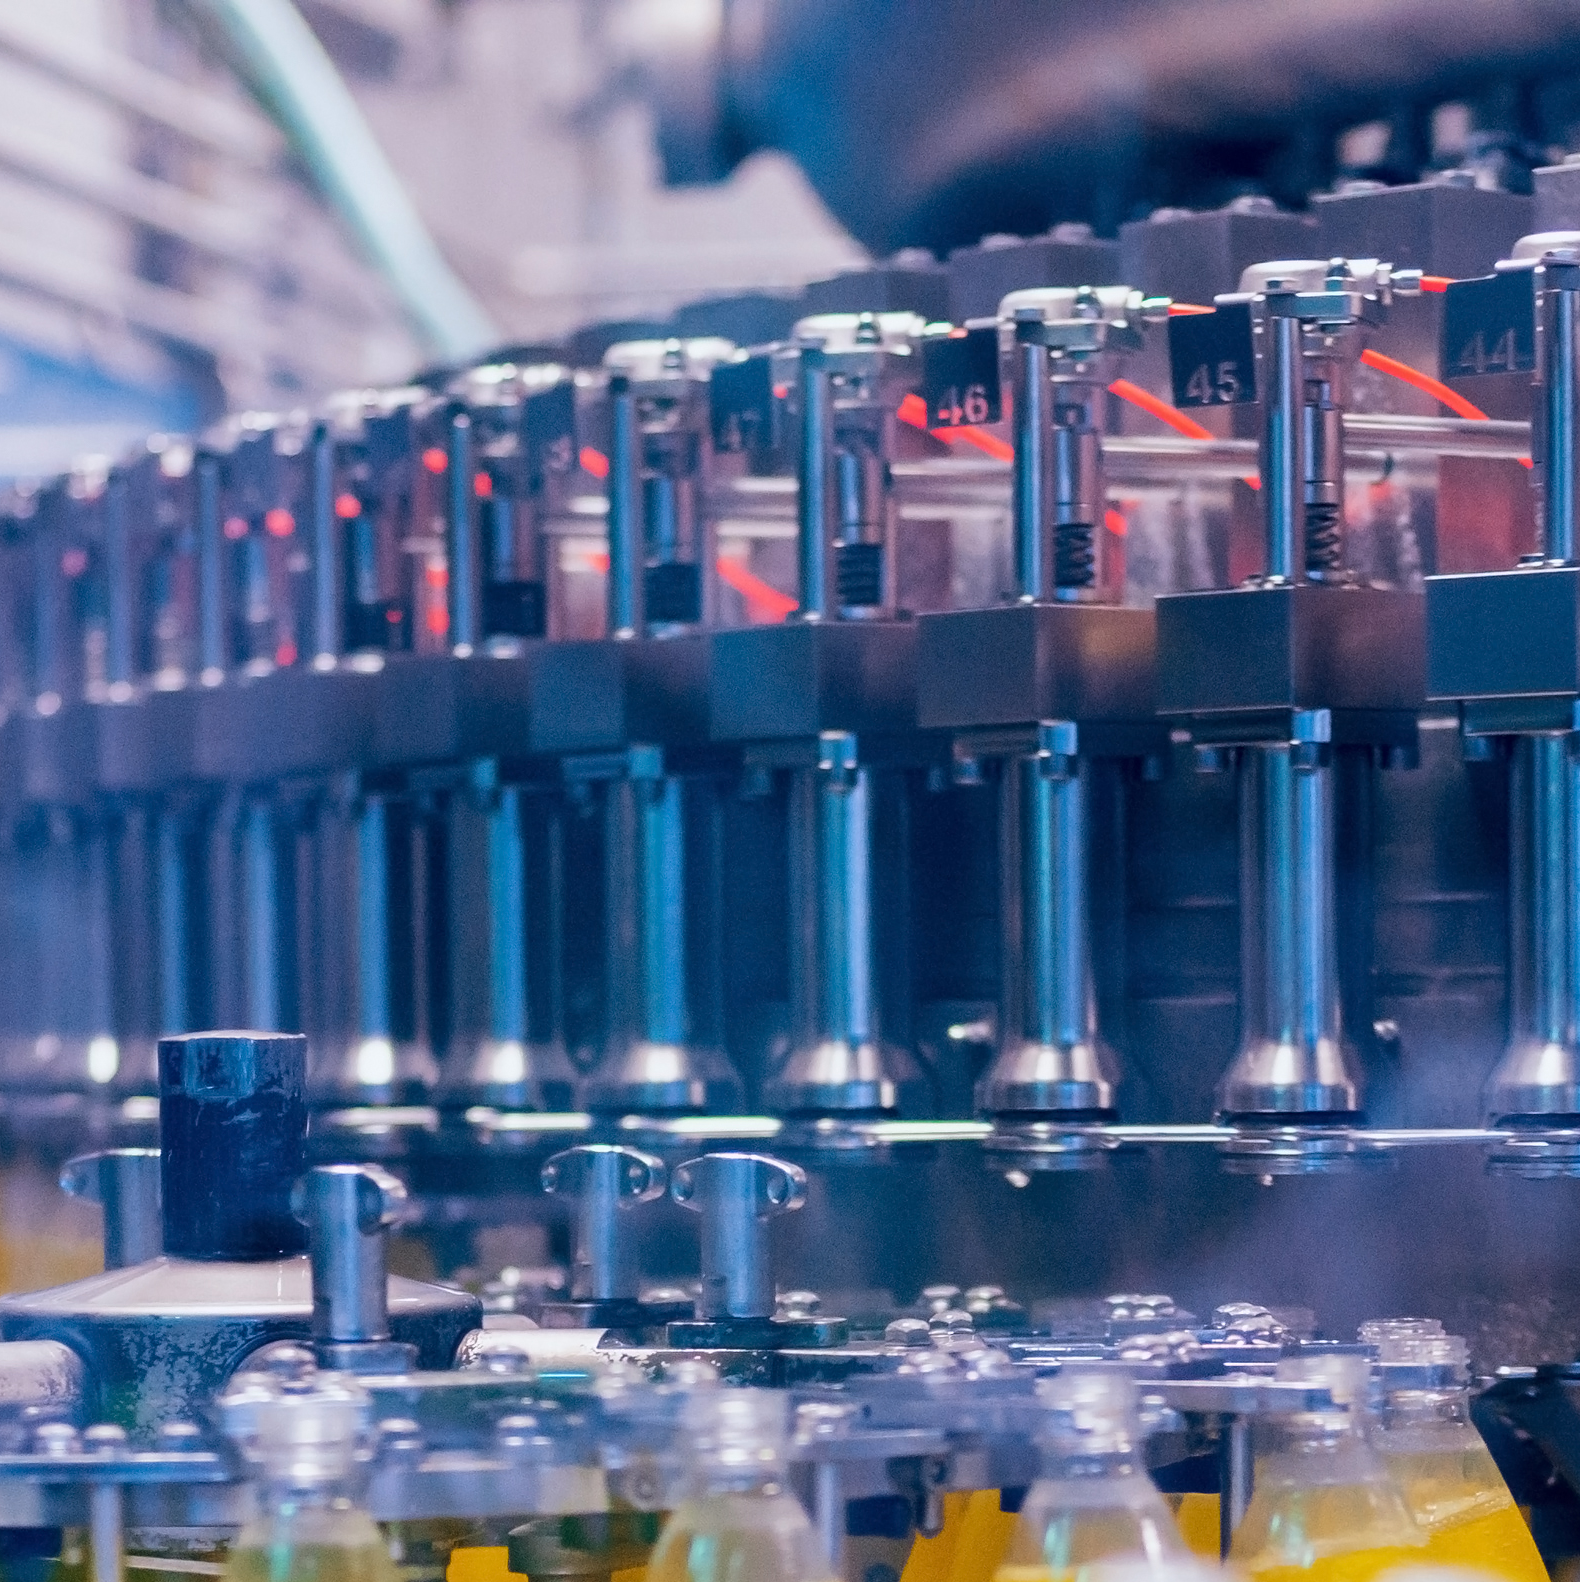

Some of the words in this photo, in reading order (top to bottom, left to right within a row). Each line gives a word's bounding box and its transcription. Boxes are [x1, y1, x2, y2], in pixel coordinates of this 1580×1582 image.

[1459, 328, 1518, 374] 44
[1184, 361, 1241, 404] 45
[938, 384, 989, 425] 46
